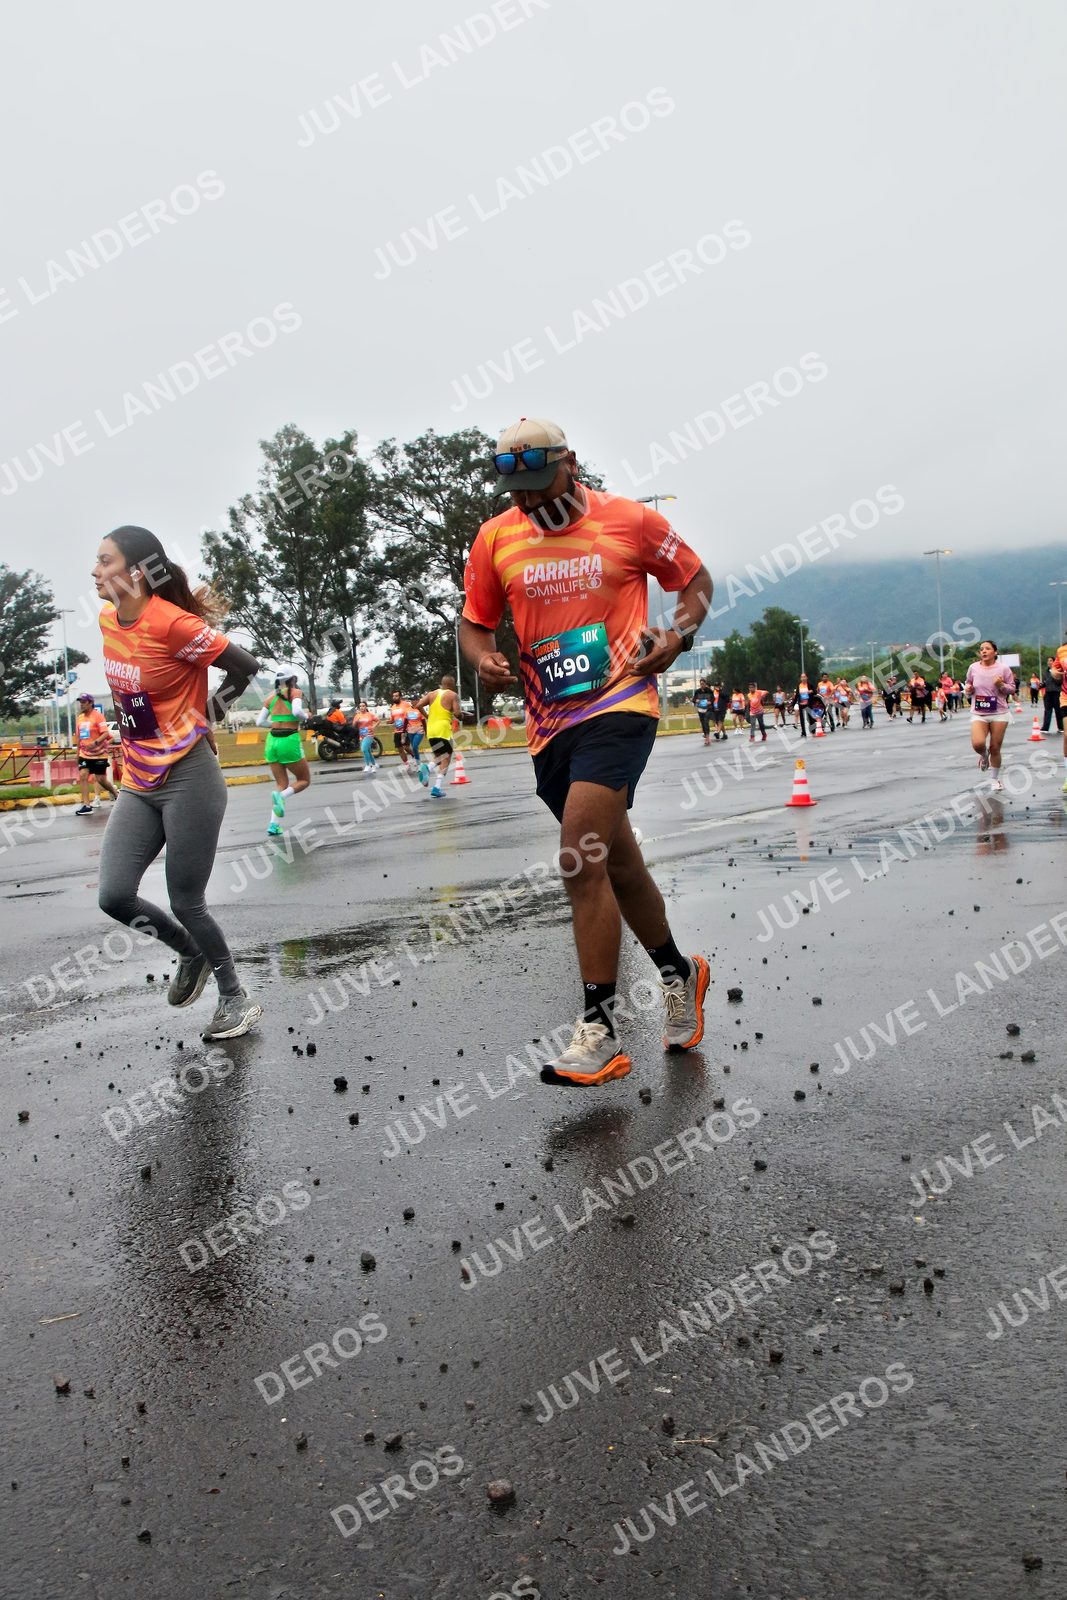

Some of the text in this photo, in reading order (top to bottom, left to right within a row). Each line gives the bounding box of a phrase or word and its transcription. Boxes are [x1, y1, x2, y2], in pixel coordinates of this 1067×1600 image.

[524, 553, 602, 584] CARRERA
[526, 579, 585, 598] OMNILIFE
[582, 629, 598, 644] 10K
[104, 658, 141, 681] ARRERA
[545, 654, 590, 682] 1490
[131, 697, 145, 707] 15K
